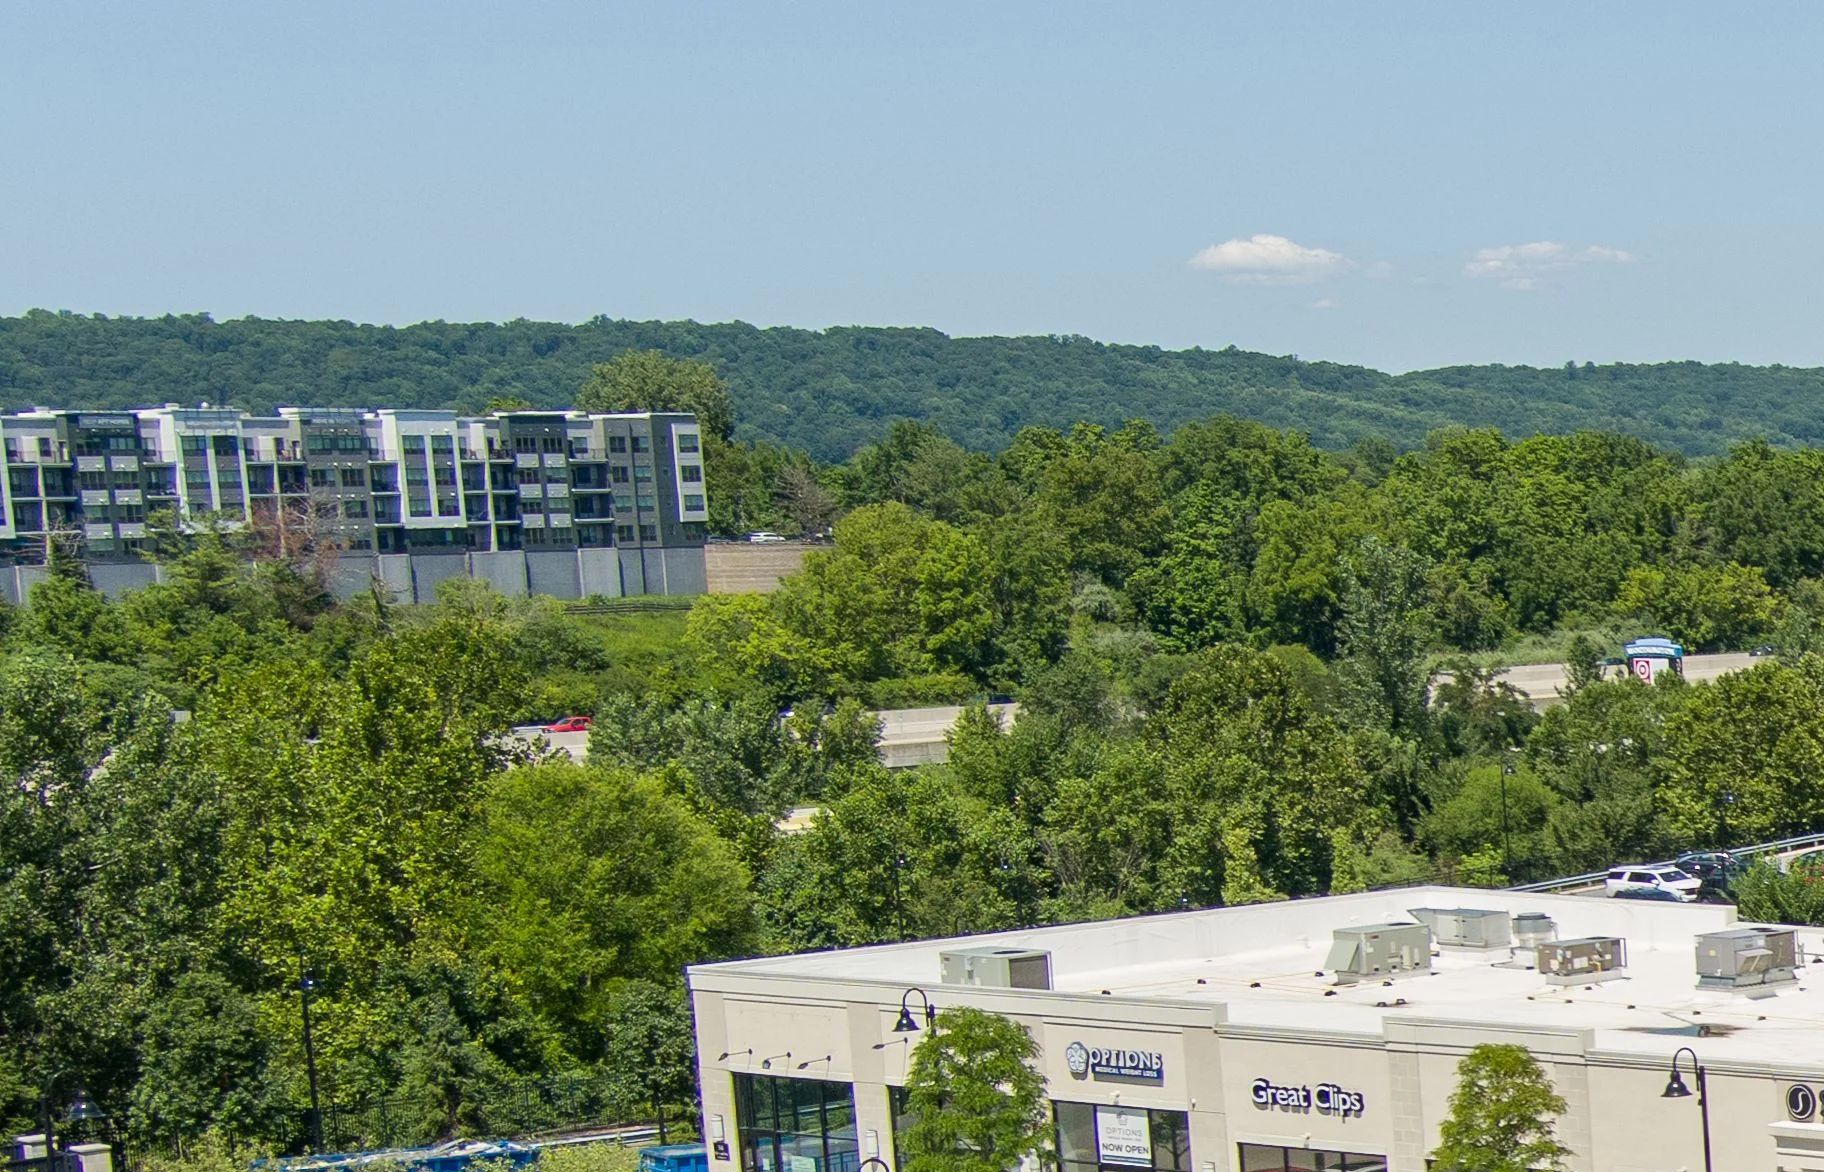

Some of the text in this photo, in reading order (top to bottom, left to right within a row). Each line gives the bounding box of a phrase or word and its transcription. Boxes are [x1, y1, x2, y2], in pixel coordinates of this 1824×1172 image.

[1089, 1048, 1162, 1070] OPTIONS
[1250, 1078, 1364, 1116] Great Clips
[1105, 1126, 1143, 1137] OPTIONS
[1102, 1143, 1149, 1154] NOW OPEN
